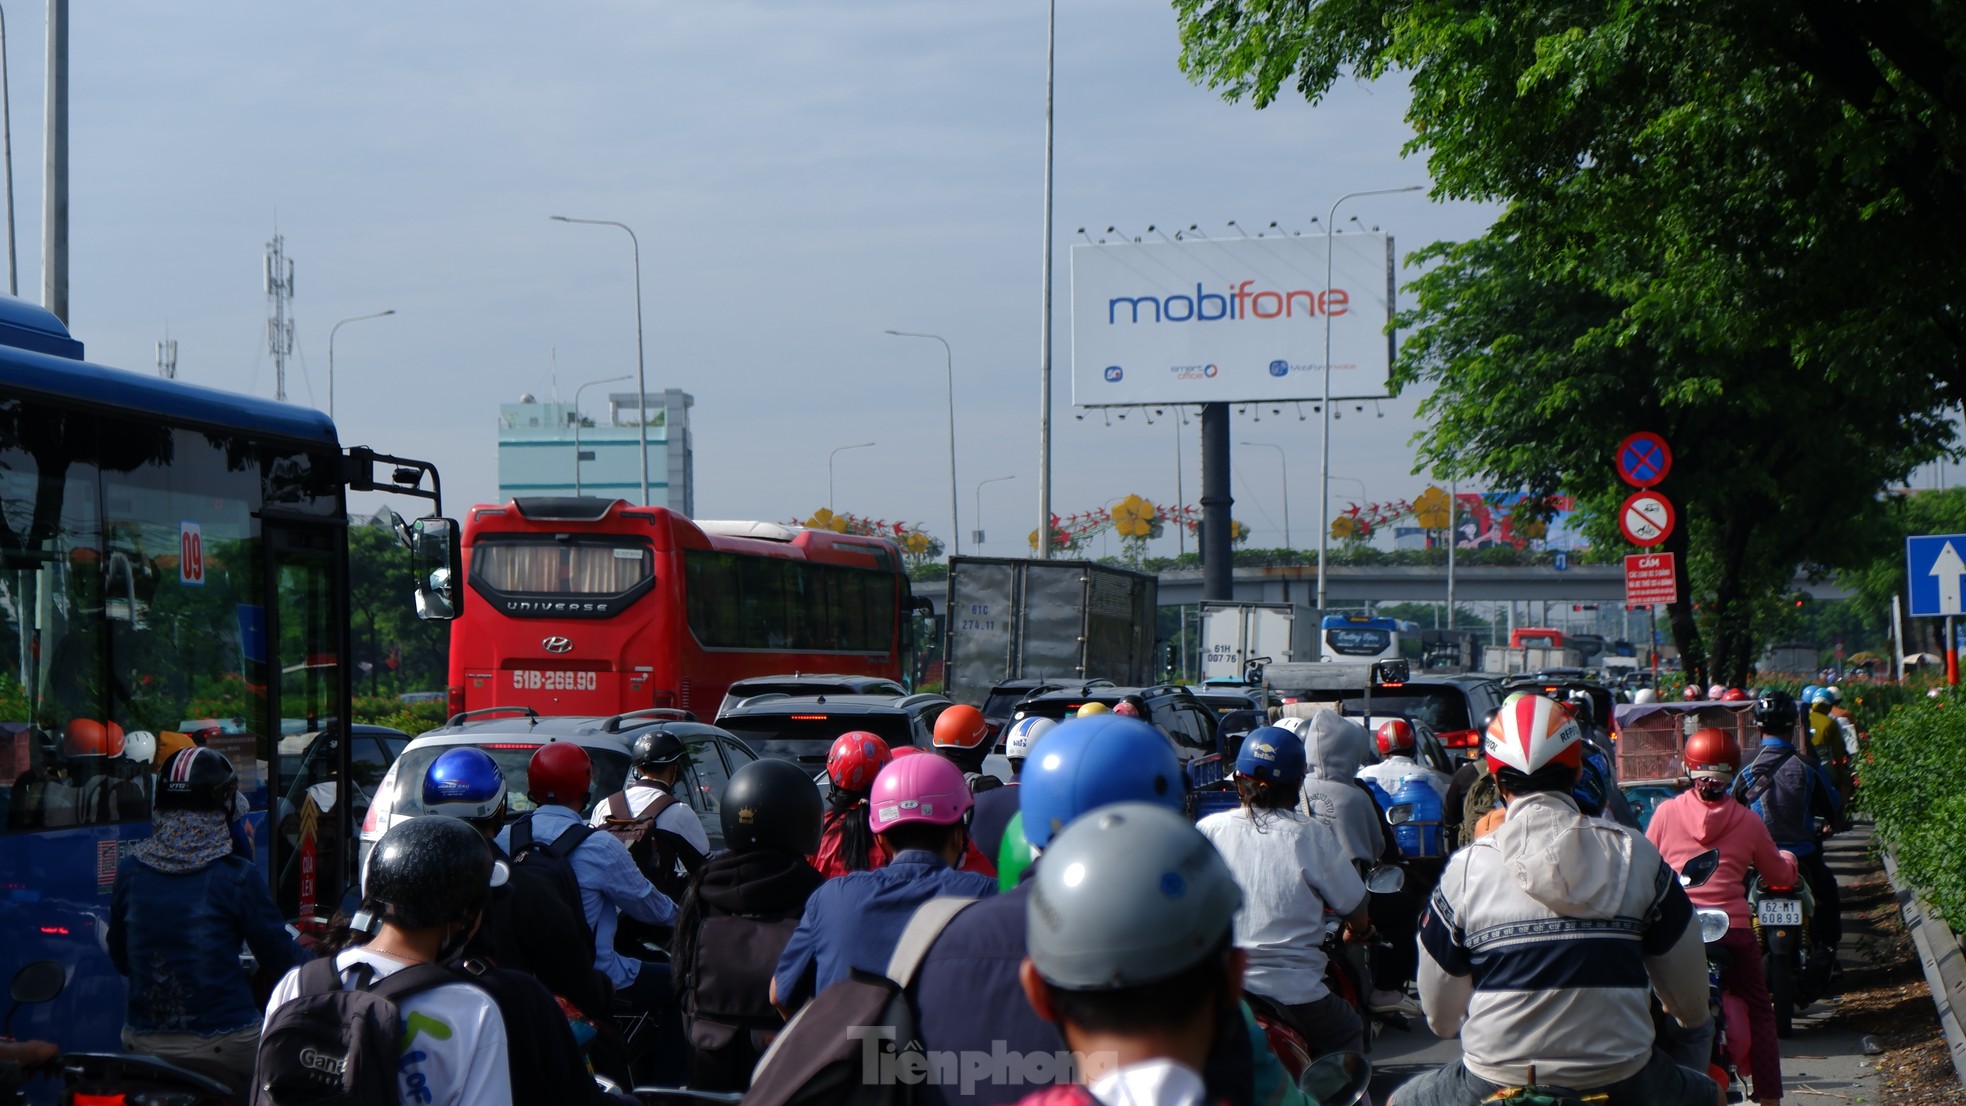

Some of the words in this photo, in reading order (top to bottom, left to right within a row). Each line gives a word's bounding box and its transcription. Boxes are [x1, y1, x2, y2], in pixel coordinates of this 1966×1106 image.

[1109, 280, 1349, 324] mobifone
[182, 531, 202, 580] 09
[507, 602, 608, 611] UNIVERSE
[972, 605, 988, 615] 61C
[962, 620, 994, 630] 274.11
[1215, 645, 1231, 653] 61H
